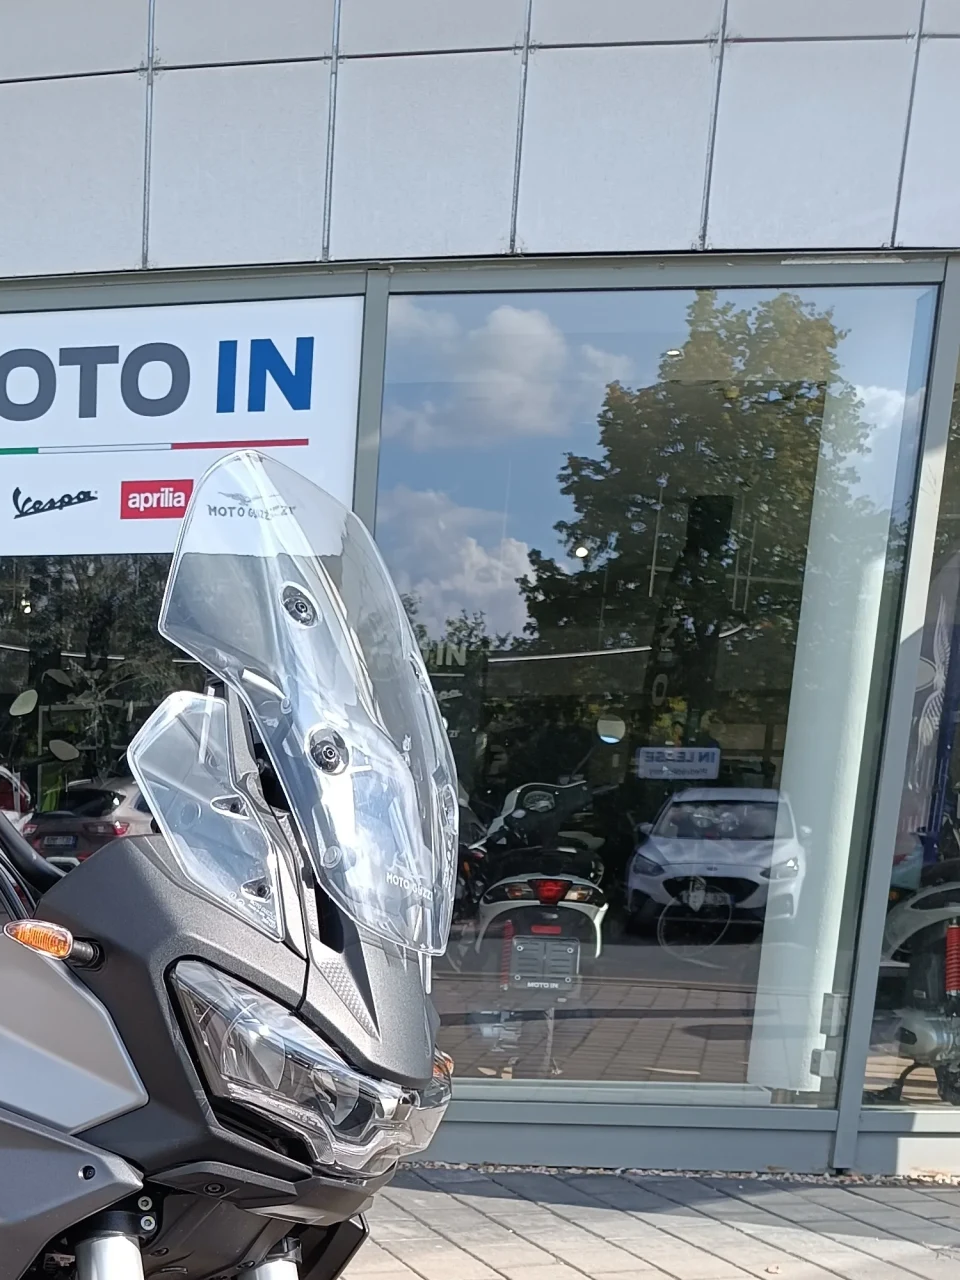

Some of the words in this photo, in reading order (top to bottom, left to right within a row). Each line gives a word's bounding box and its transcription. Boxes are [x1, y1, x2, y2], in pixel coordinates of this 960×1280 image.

[216, 336, 315, 414] IN
[12, 487, 98, 519] Vespa
[127, 487, 186, 512] aprilia
[206, 505, 246, 518] MOTO
[386, 871, 410, 890] MOTO
